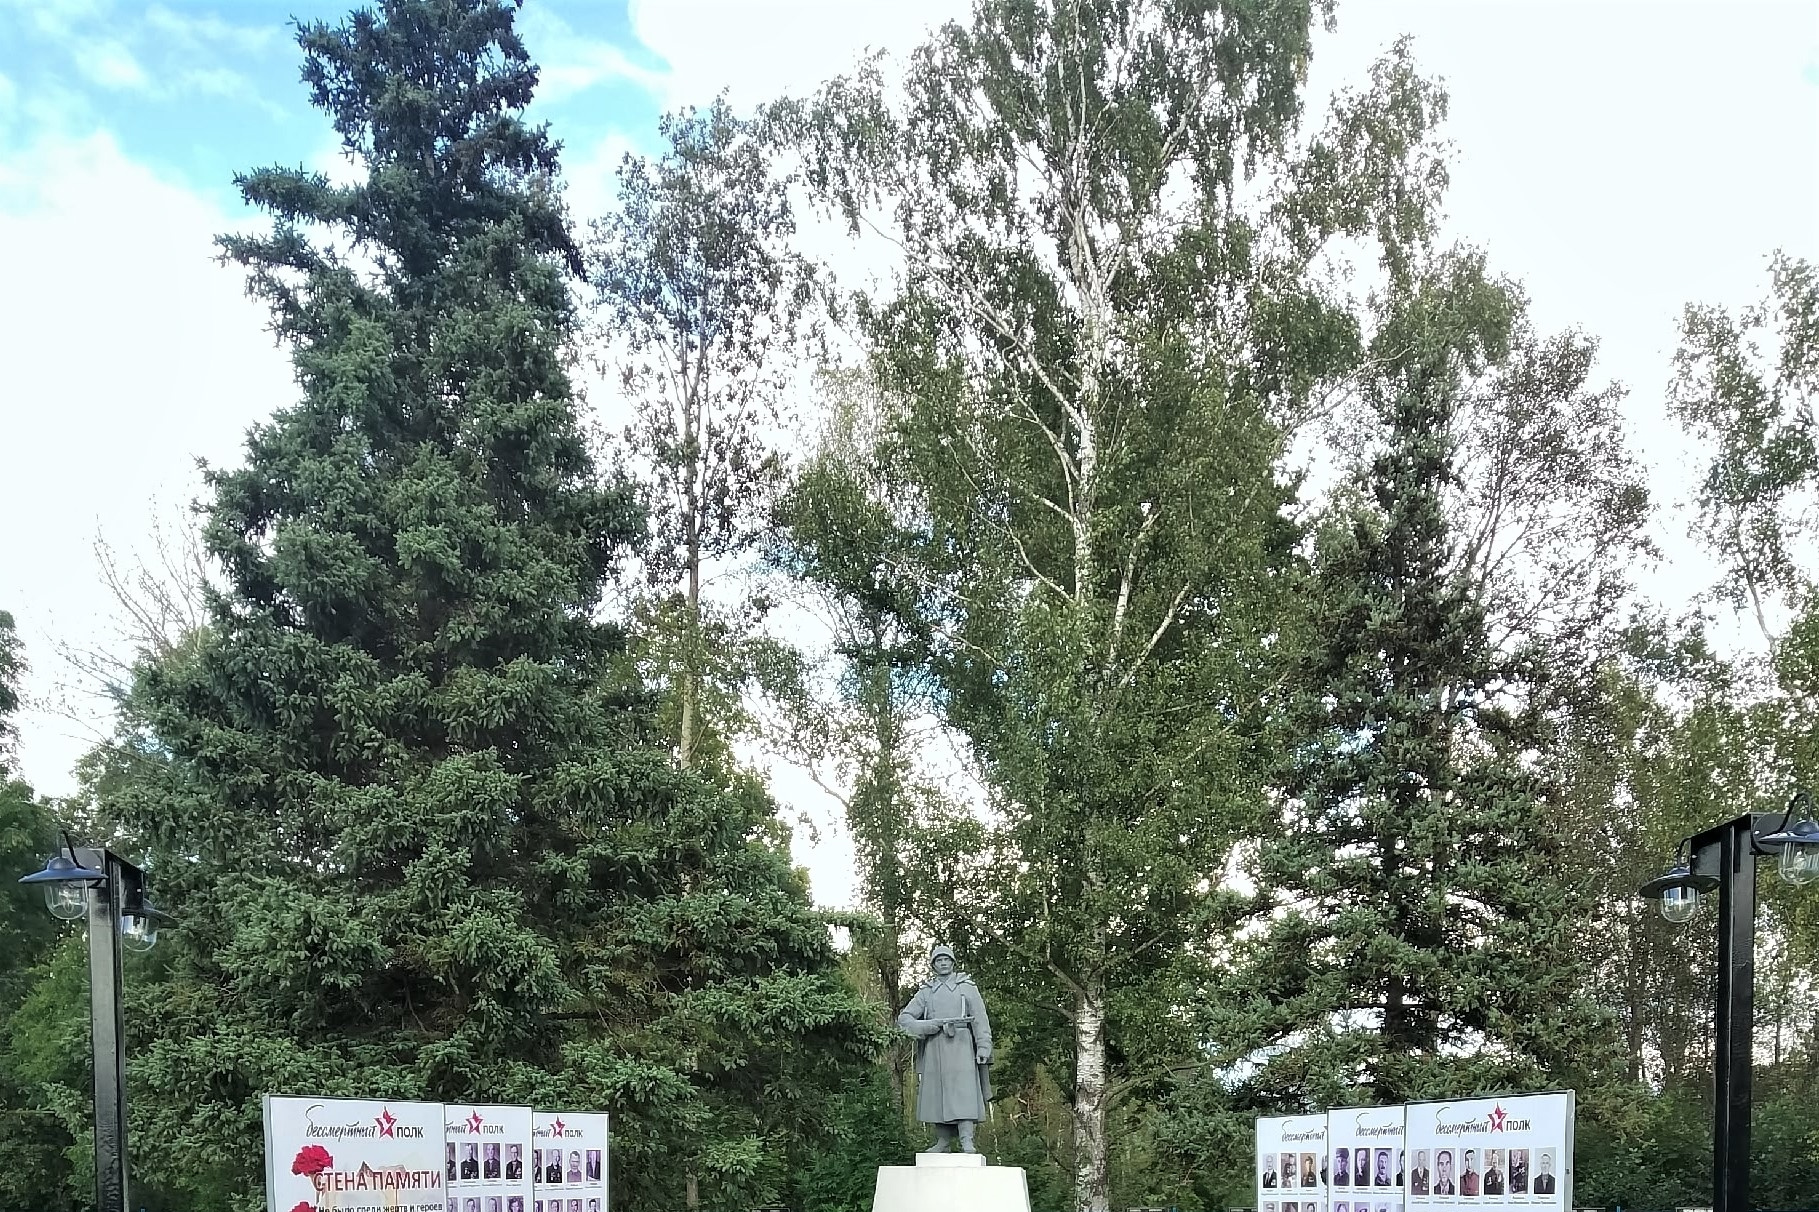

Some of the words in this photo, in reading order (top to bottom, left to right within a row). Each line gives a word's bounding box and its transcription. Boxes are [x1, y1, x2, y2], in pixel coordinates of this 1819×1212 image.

[313, 1171, 368, 1192] СТЕНА
[372, 1170, 442, 1191] ПАМЯТИ
[409, 1204, 415, 1212] и
